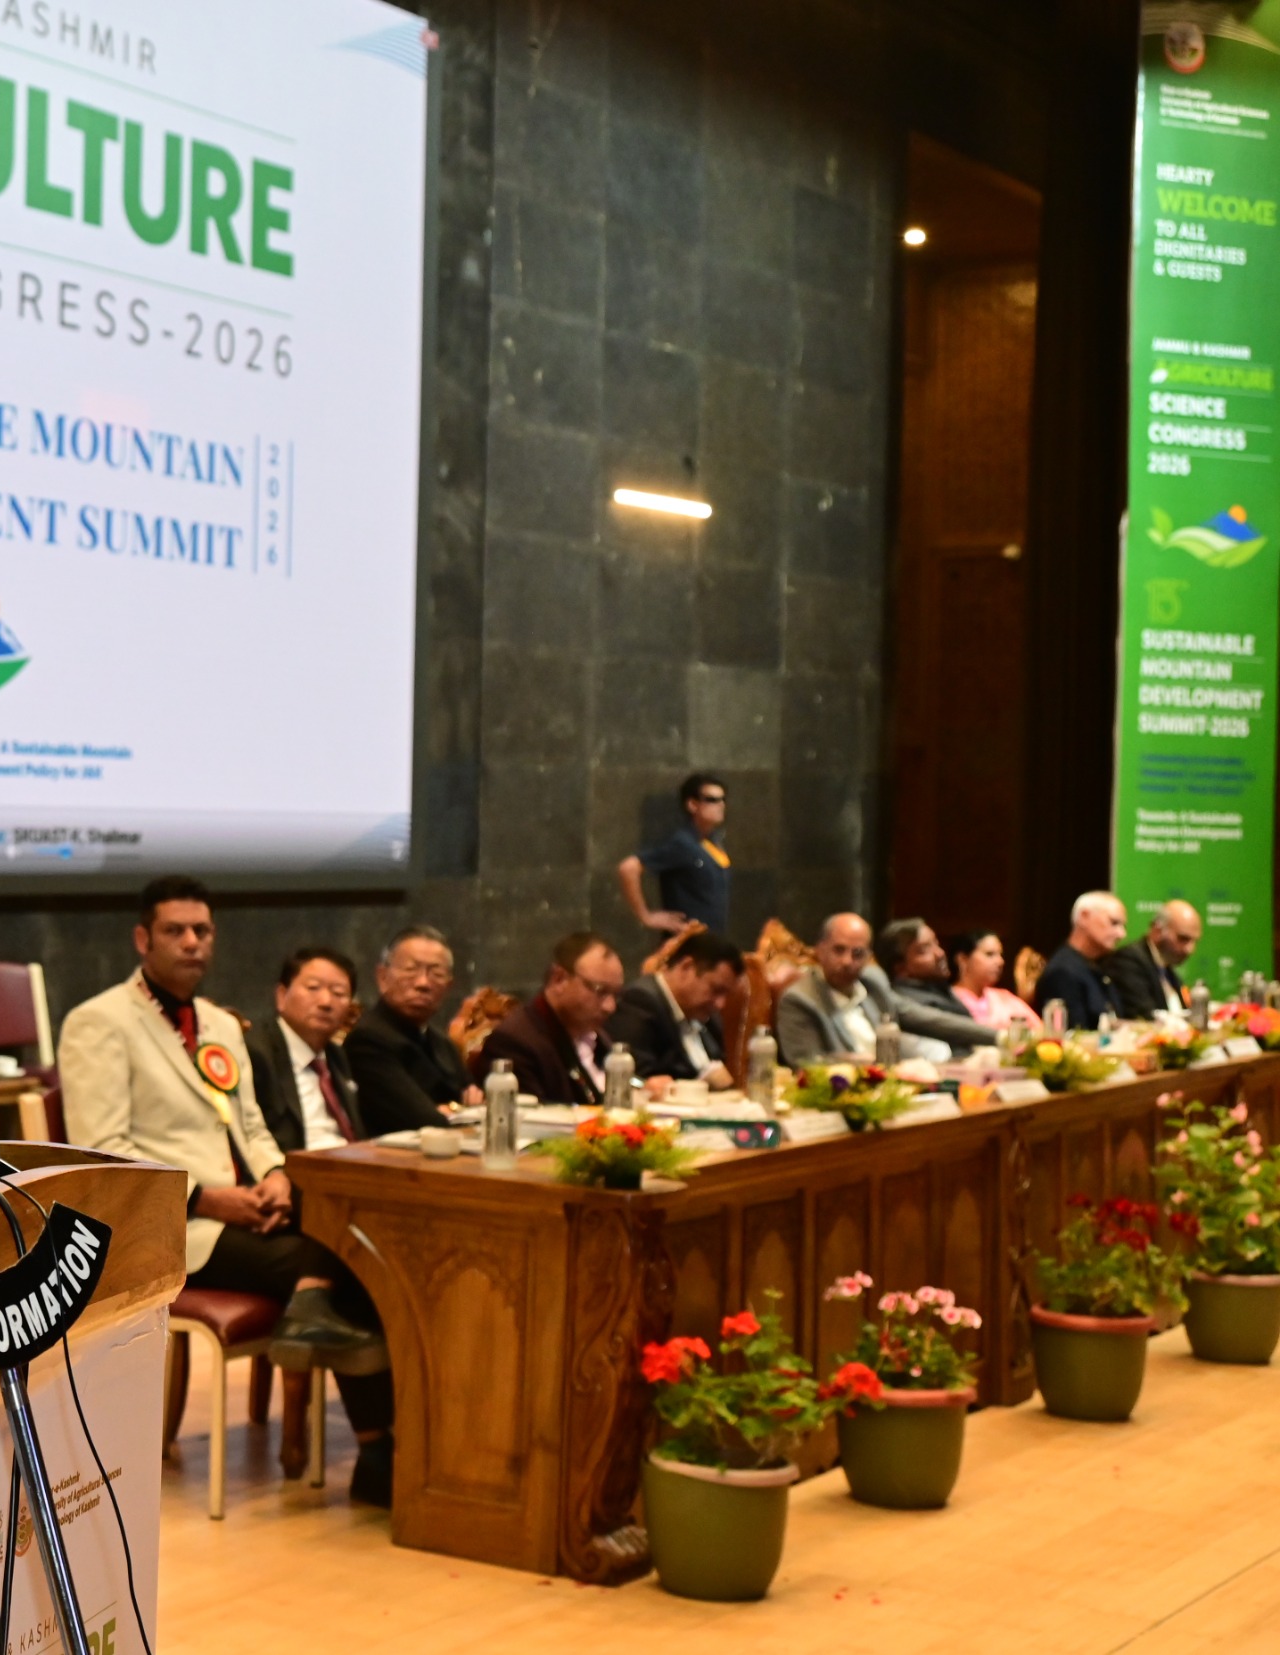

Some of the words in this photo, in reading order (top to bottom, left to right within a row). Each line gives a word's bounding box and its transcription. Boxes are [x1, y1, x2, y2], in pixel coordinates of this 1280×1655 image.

[1156, 163, 1214, 187] HEARTY
[1156, 187, 1276, 226] WELCOME
[1155, 218, 1177, 239] TO
[1179, 222, 1208, 242] ALL
[1168, 262, 1223, 283] GUESTS
[1149, 391, 1227, 420] SCIENCE
[30, 408, 245, 488] MOUNTAIN
[1148, 421, 1247, 451] CONGRESS
[1147, 451, 1192, 477] 2026
[77, 503, 243, 569] SUMMIT
[1141, 628, 1256, 656] SUSTAINABLE
[1140, 656, 1233, 682] MOUNTAIN
[1139, 683, 1265, 712] DEVELOPMENT
[51, 1472, 81, 1496] r-e-Kashmir
[73, 1476, 102, 1502] Agricultural
[101, 1466, 122, 1486] Sences
[81, 1495, 101, 1515] Kashmir
